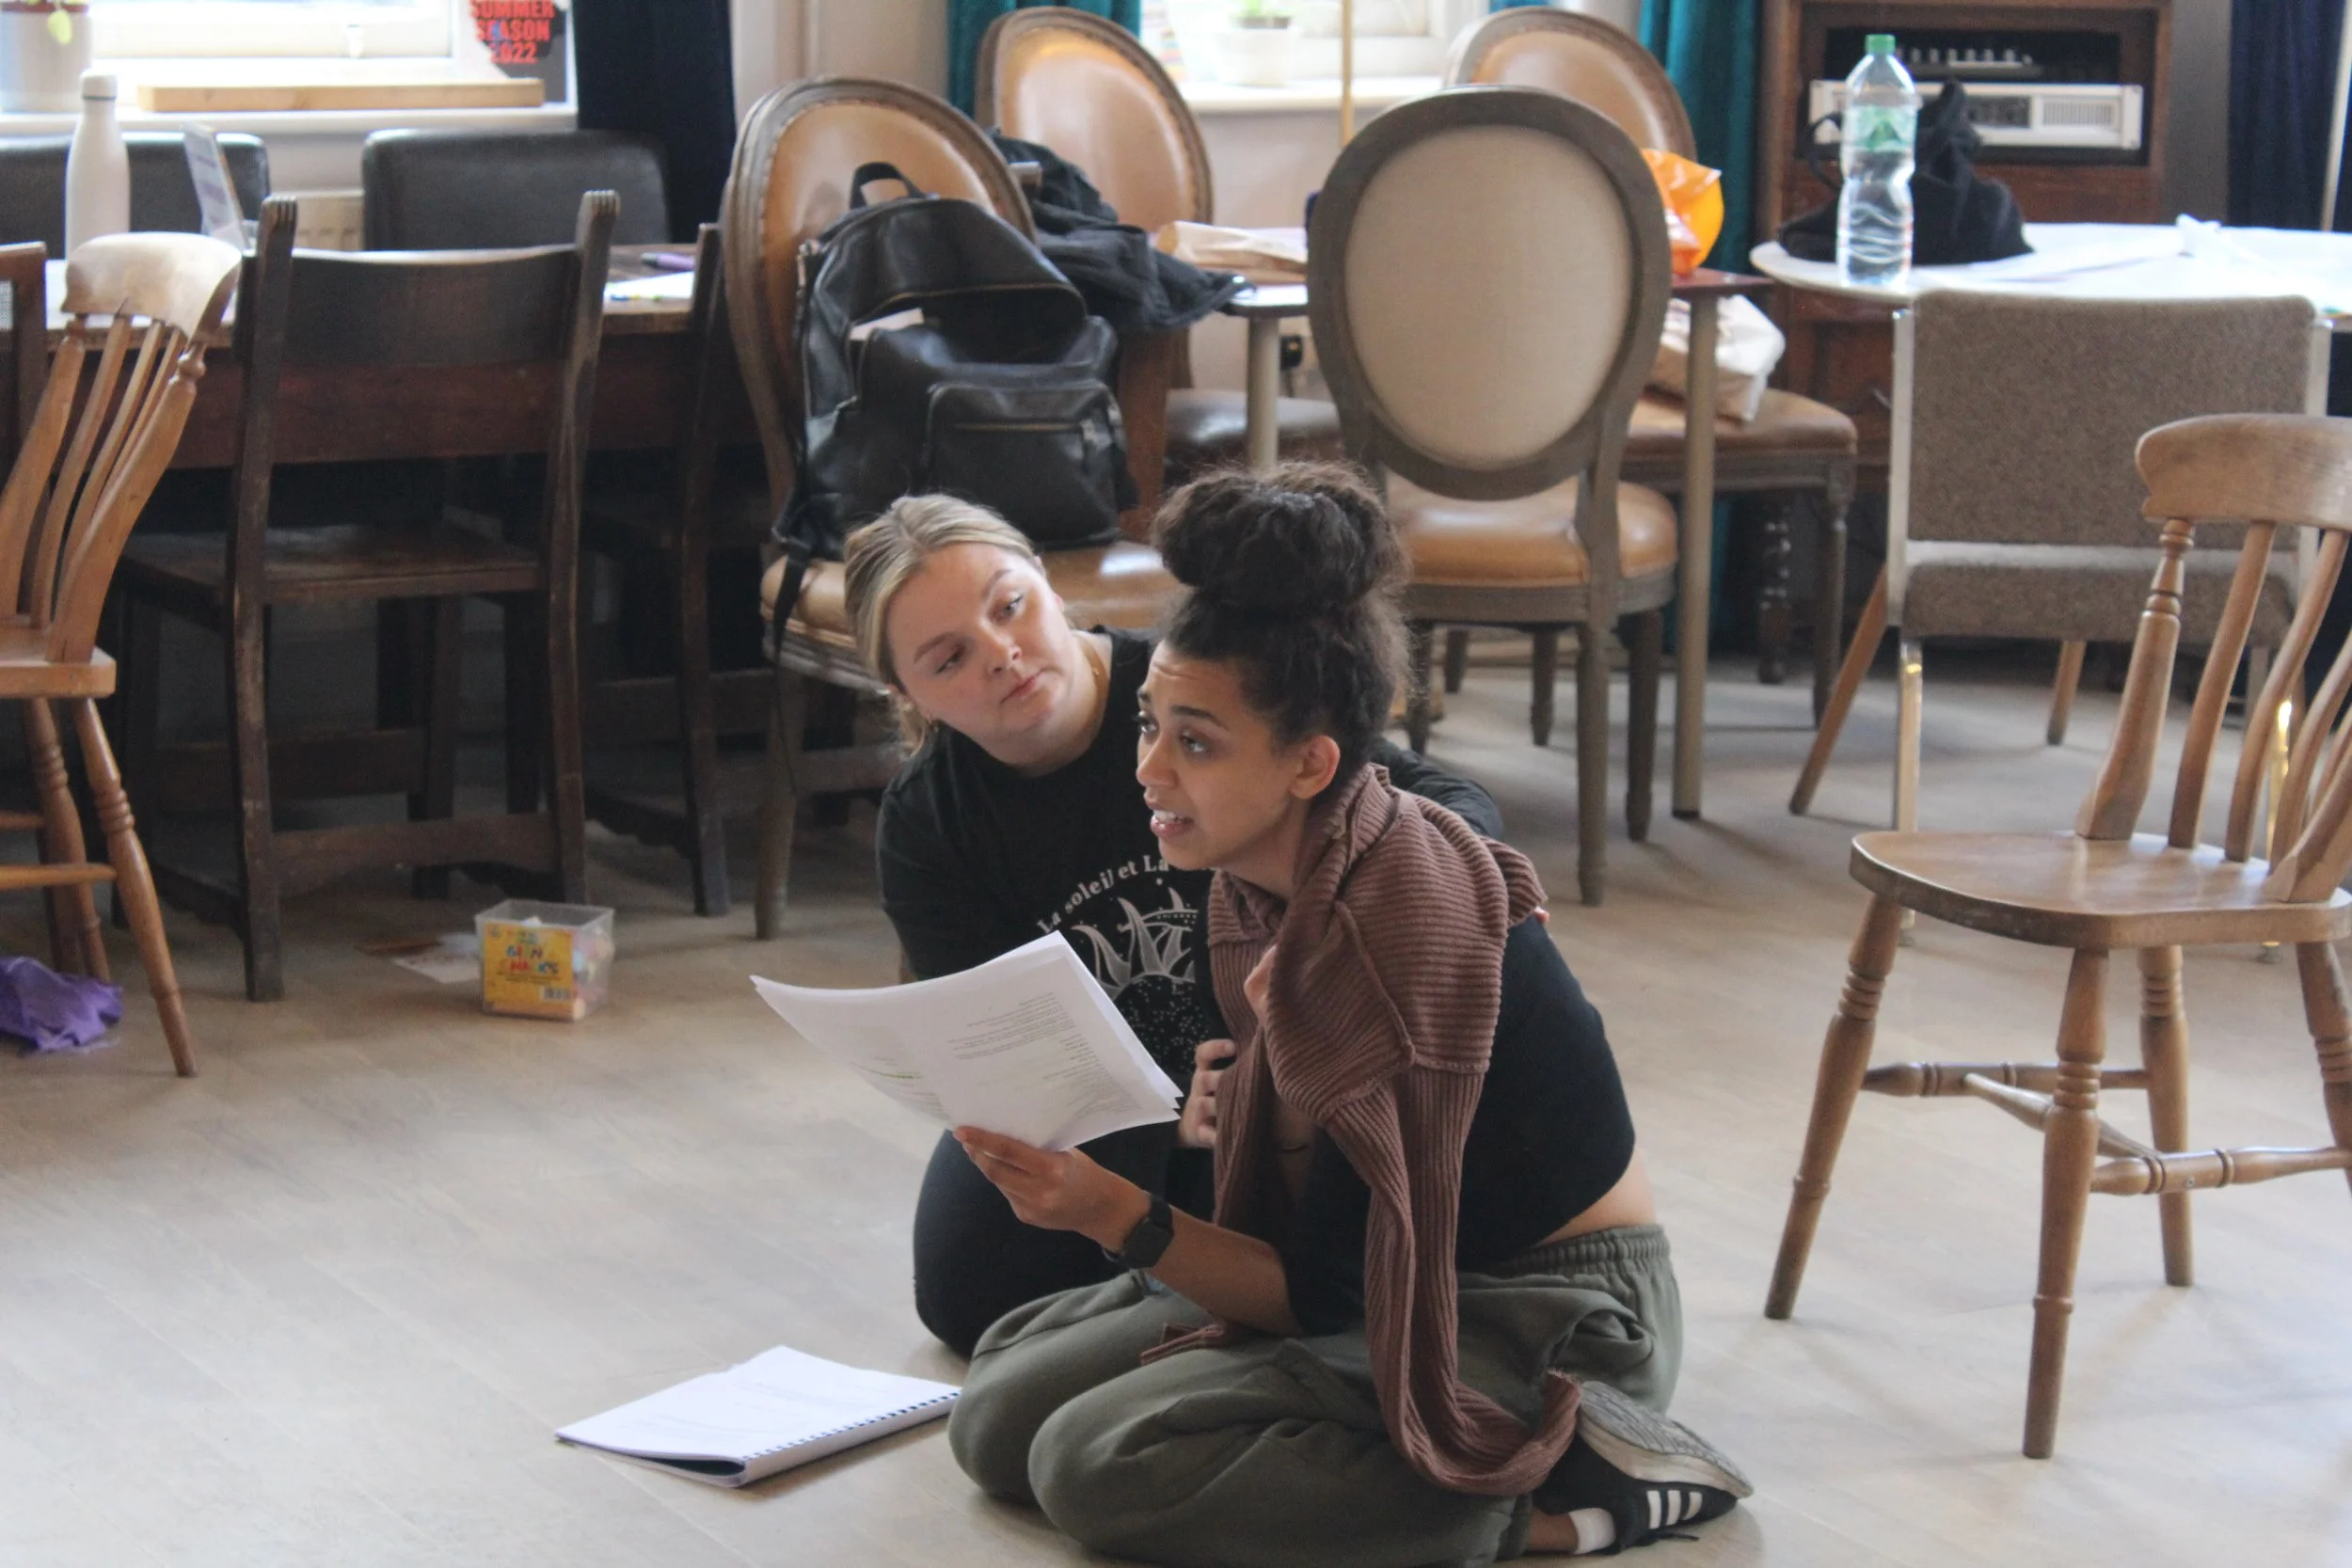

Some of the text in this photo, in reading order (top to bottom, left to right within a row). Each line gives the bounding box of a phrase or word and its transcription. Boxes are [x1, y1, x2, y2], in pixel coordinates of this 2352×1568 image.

[471, 0, 554, 19] SUMMER
[476, 19, 549, 40] SEASON
[1064, 869, 1117, 914] soleil
[1118, 861, 1138, 879] et
